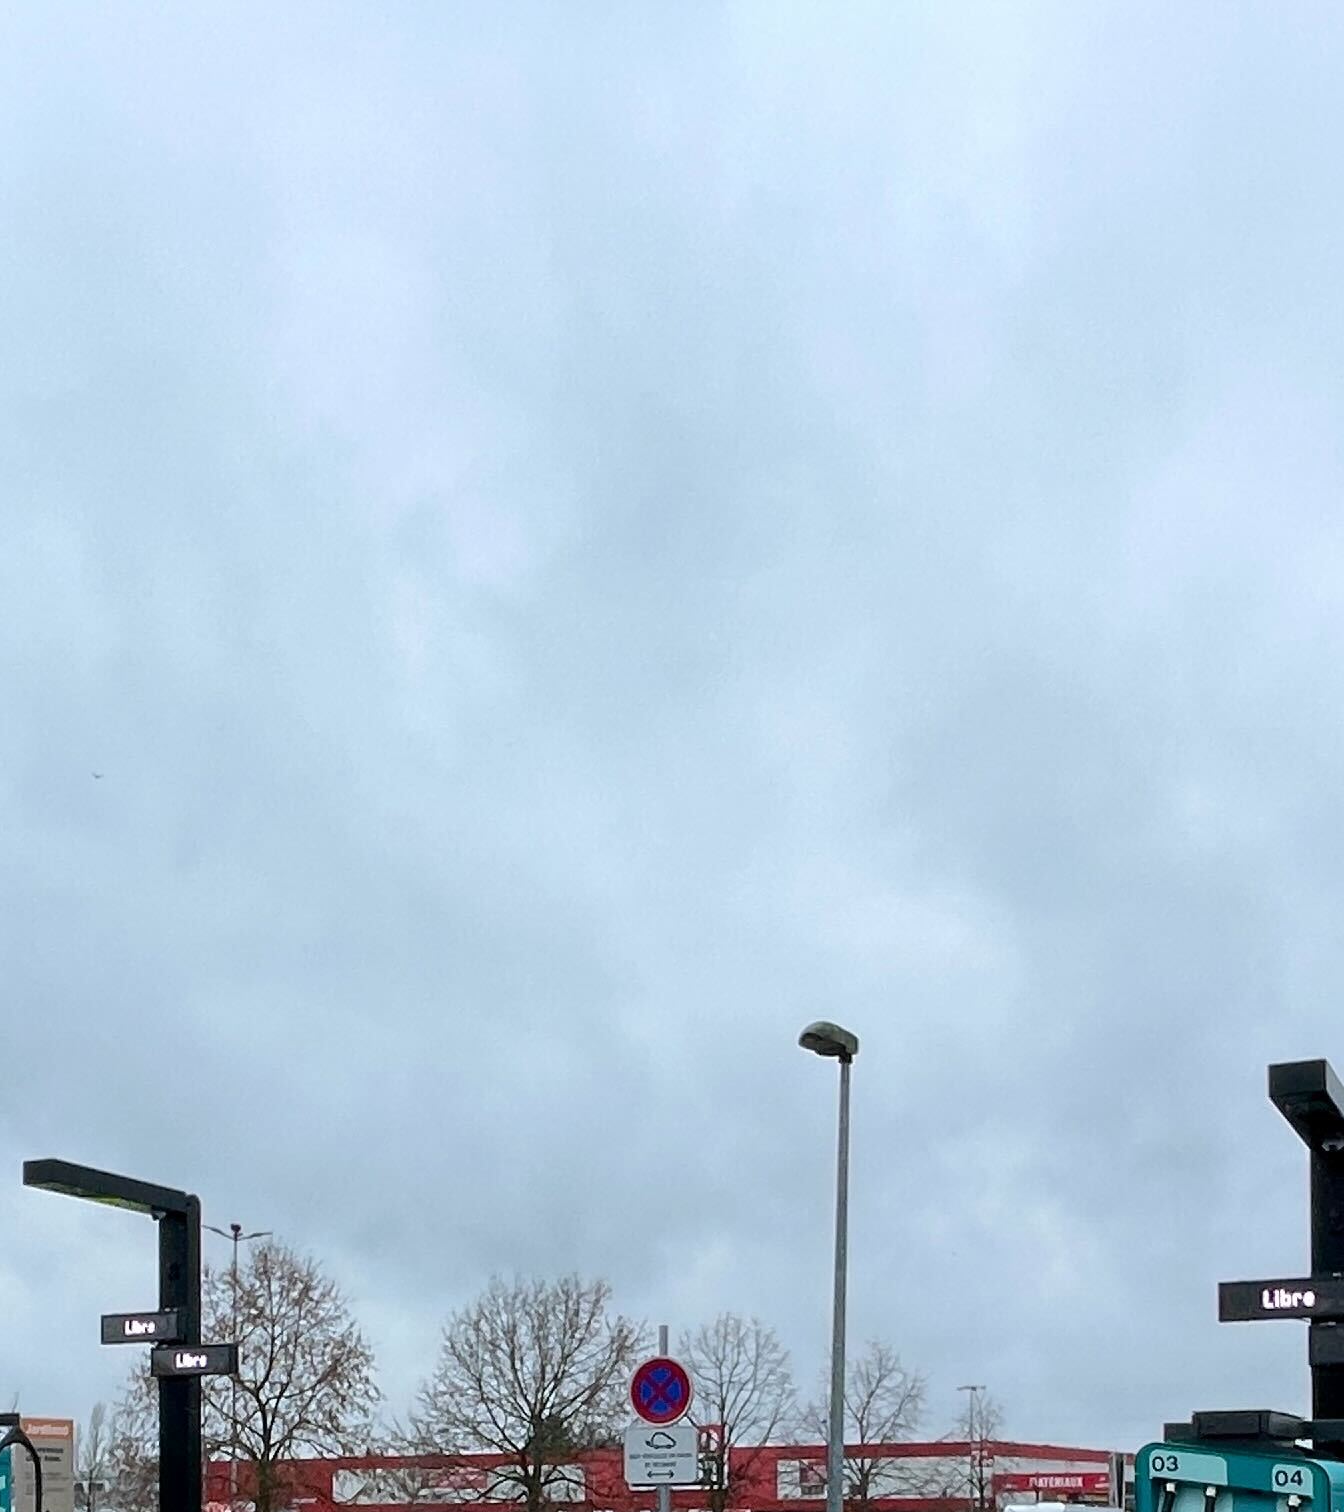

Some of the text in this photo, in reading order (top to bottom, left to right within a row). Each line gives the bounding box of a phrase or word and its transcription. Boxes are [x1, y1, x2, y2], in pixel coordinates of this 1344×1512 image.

[1262, 1288, 1316, 1310] Libre
[123, 1320, 156, 1336] Libre
[175, 1352, 208, 1369] Libre
[1152, 1456, 1179, 1472] 03
[1274, 1470, 1303, 1487] 04
